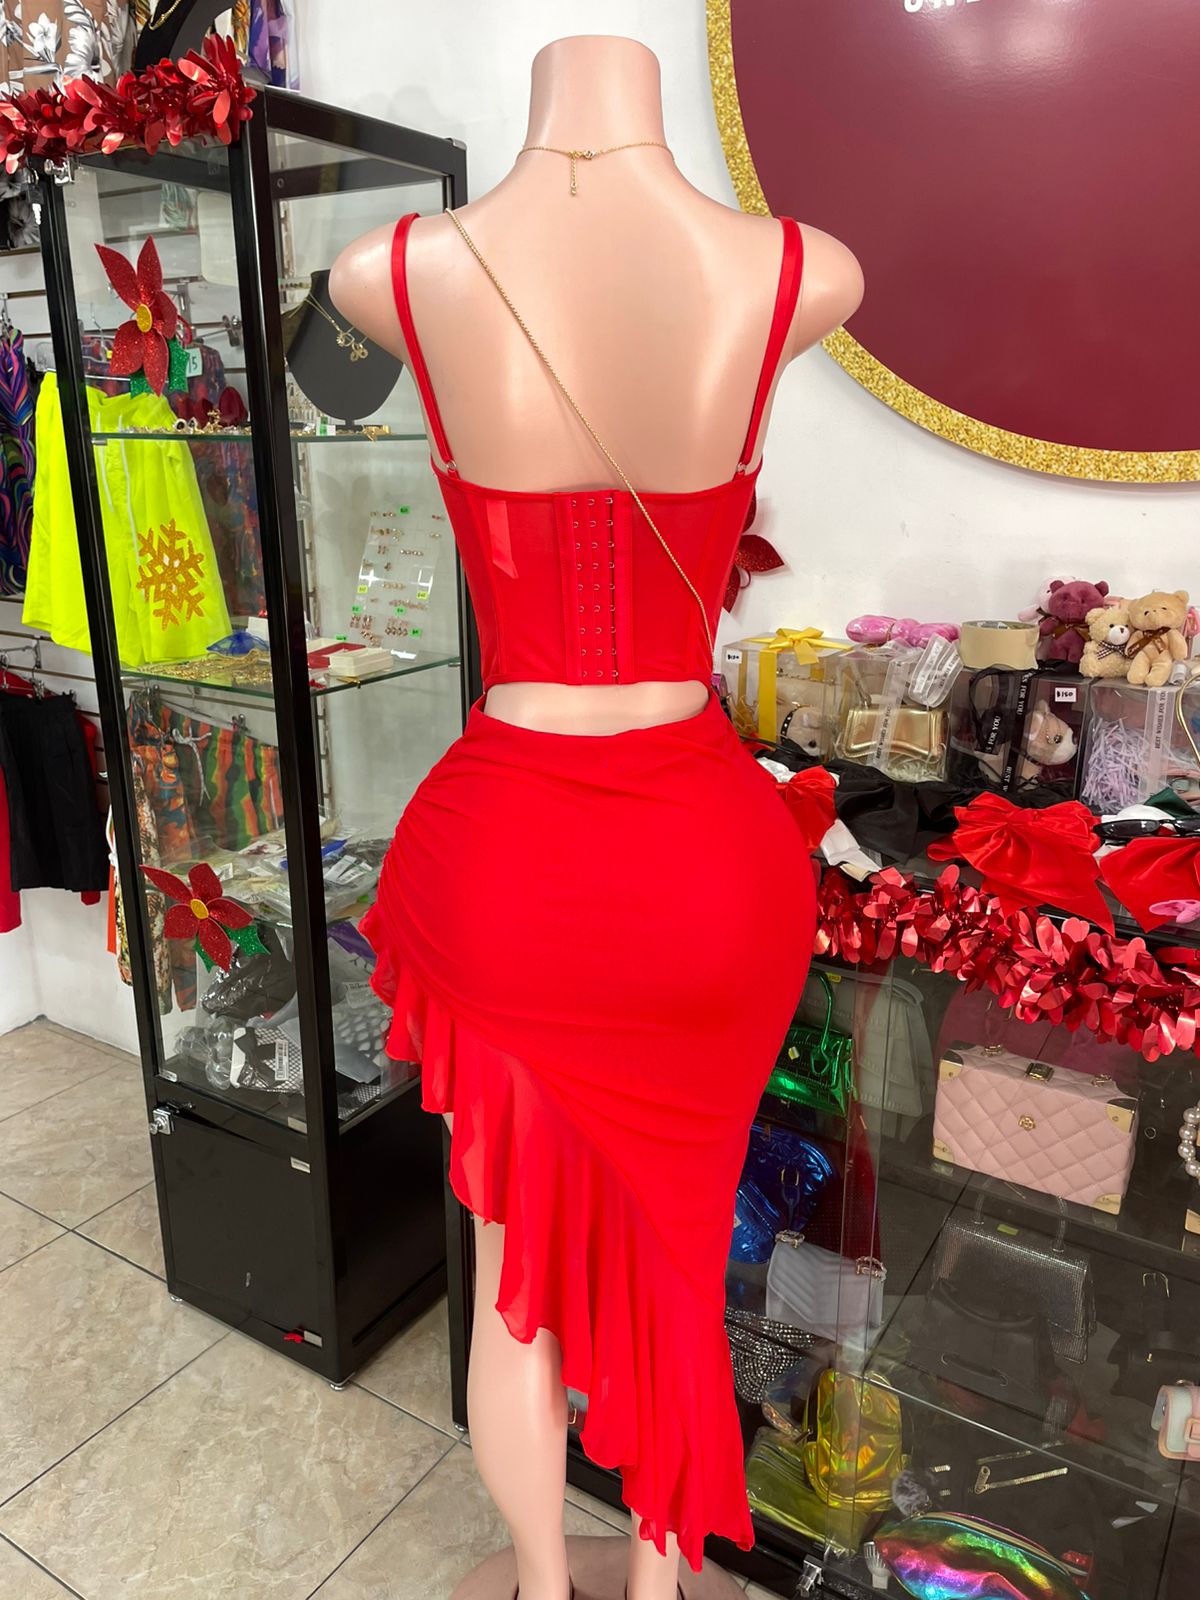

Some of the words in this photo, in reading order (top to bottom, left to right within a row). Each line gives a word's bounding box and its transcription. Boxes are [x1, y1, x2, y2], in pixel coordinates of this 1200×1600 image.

[1019, 685, 1027, 699] FOR
[1016, 700, 1024, 715] YOU
[991, 715, 1002, 731] YOU
[987, 731, 998, 746] FOR
